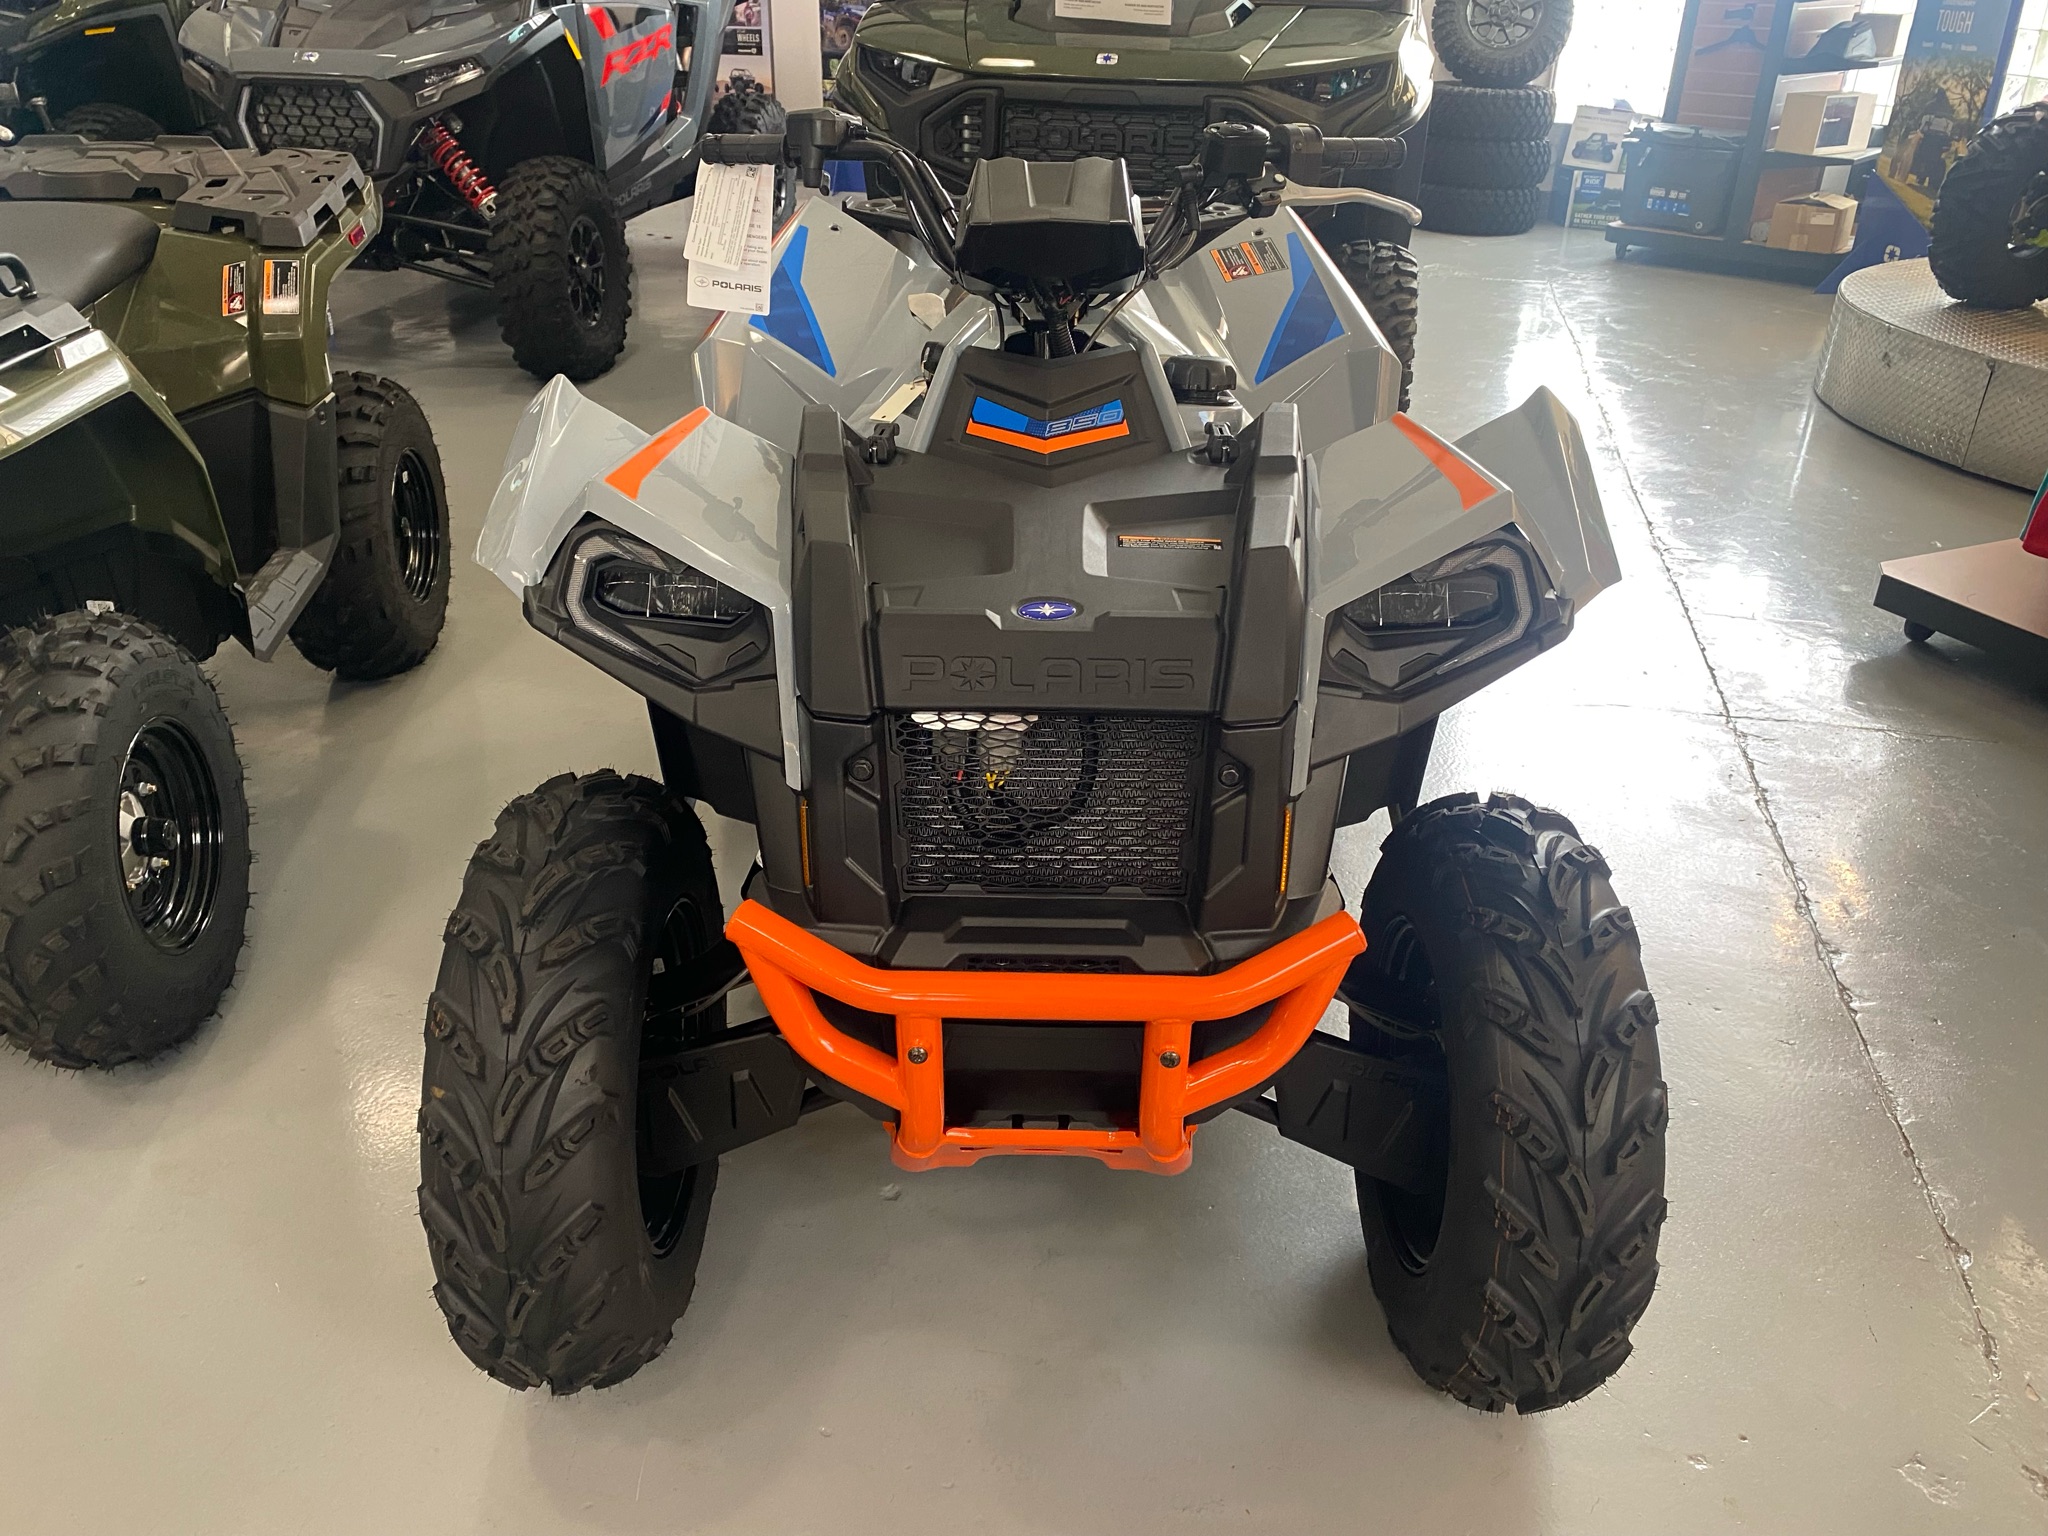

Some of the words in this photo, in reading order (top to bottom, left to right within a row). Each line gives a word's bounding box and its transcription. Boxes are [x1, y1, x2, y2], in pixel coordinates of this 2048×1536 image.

[1936, 9, 1975, 34] TOUGH
[737, 33, 760, 42] WHEELS
[601, 22, 672, 88] RZR
[1009, 123, 1196, 155] POLARIS
[712, 279, 762, 293] POLARIS
[1045, 408, 1124, 436] 850
[901, 654, 1196, 695] POLARIS
